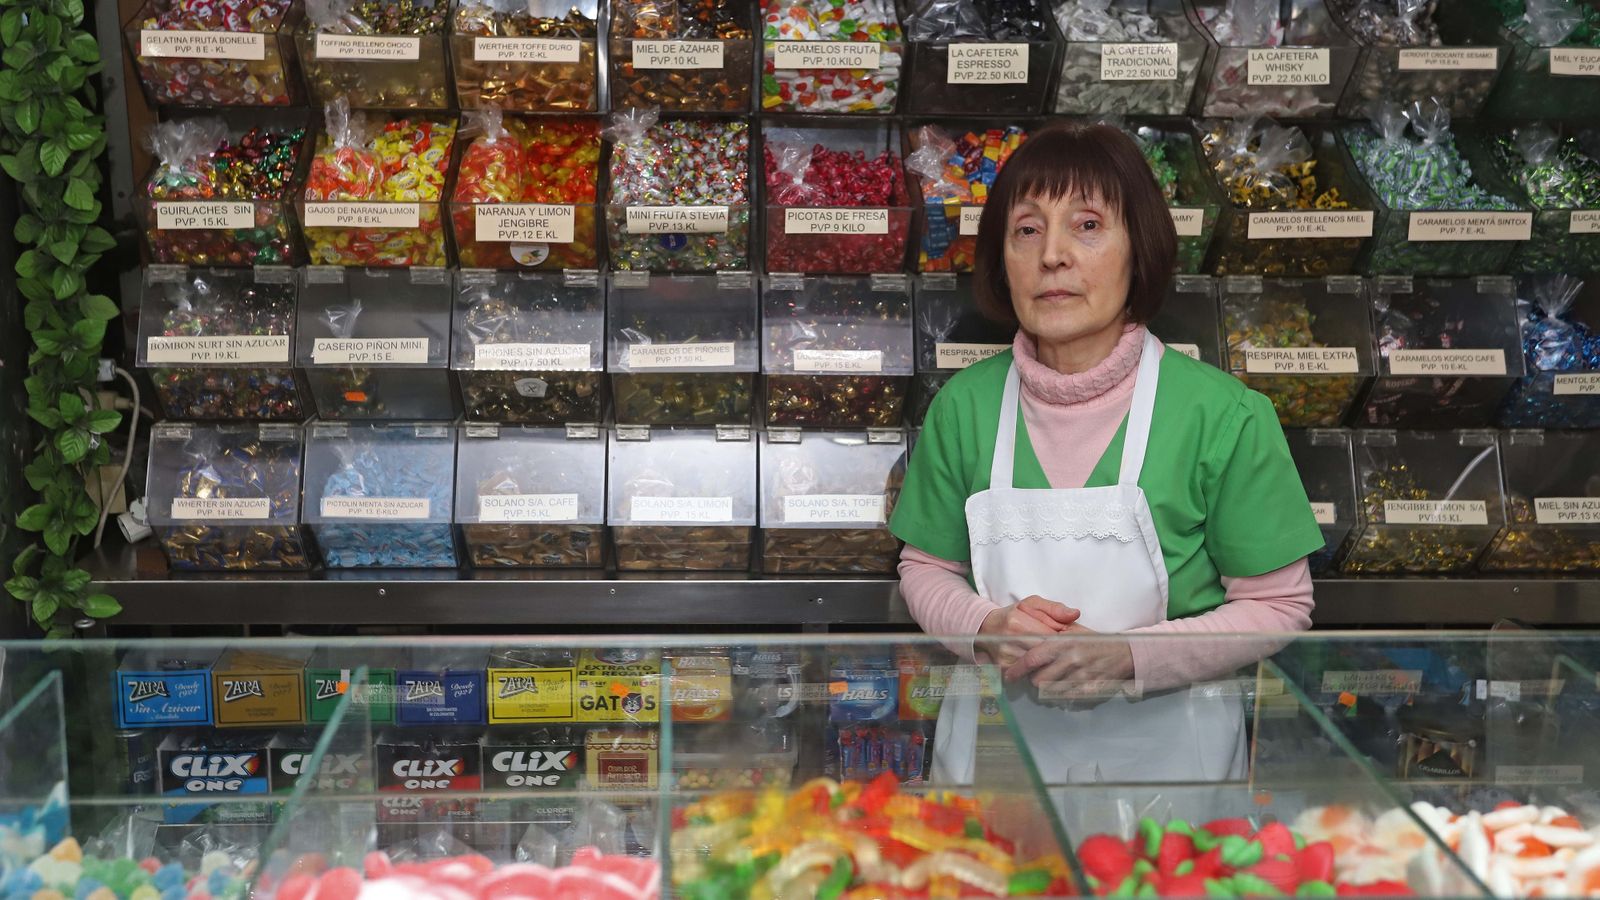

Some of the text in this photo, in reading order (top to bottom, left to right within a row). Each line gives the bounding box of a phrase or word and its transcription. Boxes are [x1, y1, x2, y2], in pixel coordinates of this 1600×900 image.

[146, 36, 188, 44] GELATINA
[636, 44, 720, 53] MIEL DE AZAHAR
[778, 45, 840, 54] CARAMELOS
[1104, 46, 1171, 55] LA CAFETERA
[952, 49, 1018, 57] LA CAFETERA
[1252, 52, 1318, 60] LA CAFETERA
[687, 57, 699, 65] KL
[957, 60, 1011, 68] ESPRESSO
[1108, 58, 1172, 66] TRADICIONAL
[1266, 64, 1304, 72] WHISKY
[1003, 71, 1026, 79] KILO
[1154, 69, 1176, 77] KILO
[160, 206, 250, 215] GUIRLACHES SIN
[308, 206, 335, 214] GAJOS
[478, 208, 570, 216] NARANJA Y LIMON
[653, 212, 687, 220] FRUTA
[690, 212, 726, 220] STEVIA
[788, 212, 886, 220] PICOTAS DE FRESA
[1253, 216, 1302, 224] CARAMELOS
[203, 218, 229, 226] 15.KL
[498, 219, 549, 228] JENGIBRE
[1416, 218, 1465, 226] CARAMELOS
[842, 224, 865, 232] KILO
[151, 341, 196, 351] BOMBON
[224, 340, 243, 348] SIN
[245, 339, 286, 348] AZUCAR
[318, 343, 364, 351] CASERIO
[366, 340, 398, 350] PIÑON
[526, 347, 542, 356] SIN
[1247, 352, 1295, 360] RESPIRAL
[1298, 352, 1320, 360] MIEL
[1308, 362, 1329, 370] E-KL
[485, 499, 525, 507] SOLANO
[550, 498, 575, 506] CAFE
[634, 500, 674, 508] SOLANO
[789, 499, 829, 507] SOLANO
[1538, 502, 1560, 510] MIEL
[1385, 503, 1432, 511] JENGIBRE
[128, 680, 167, 702] ZARA
[223, 680, 262, 701] ZARA
[406, 680, 443, 700] ZARA
[498, 677, 538, 698] ZARA
[841, 689, 888, 700] HALLS
